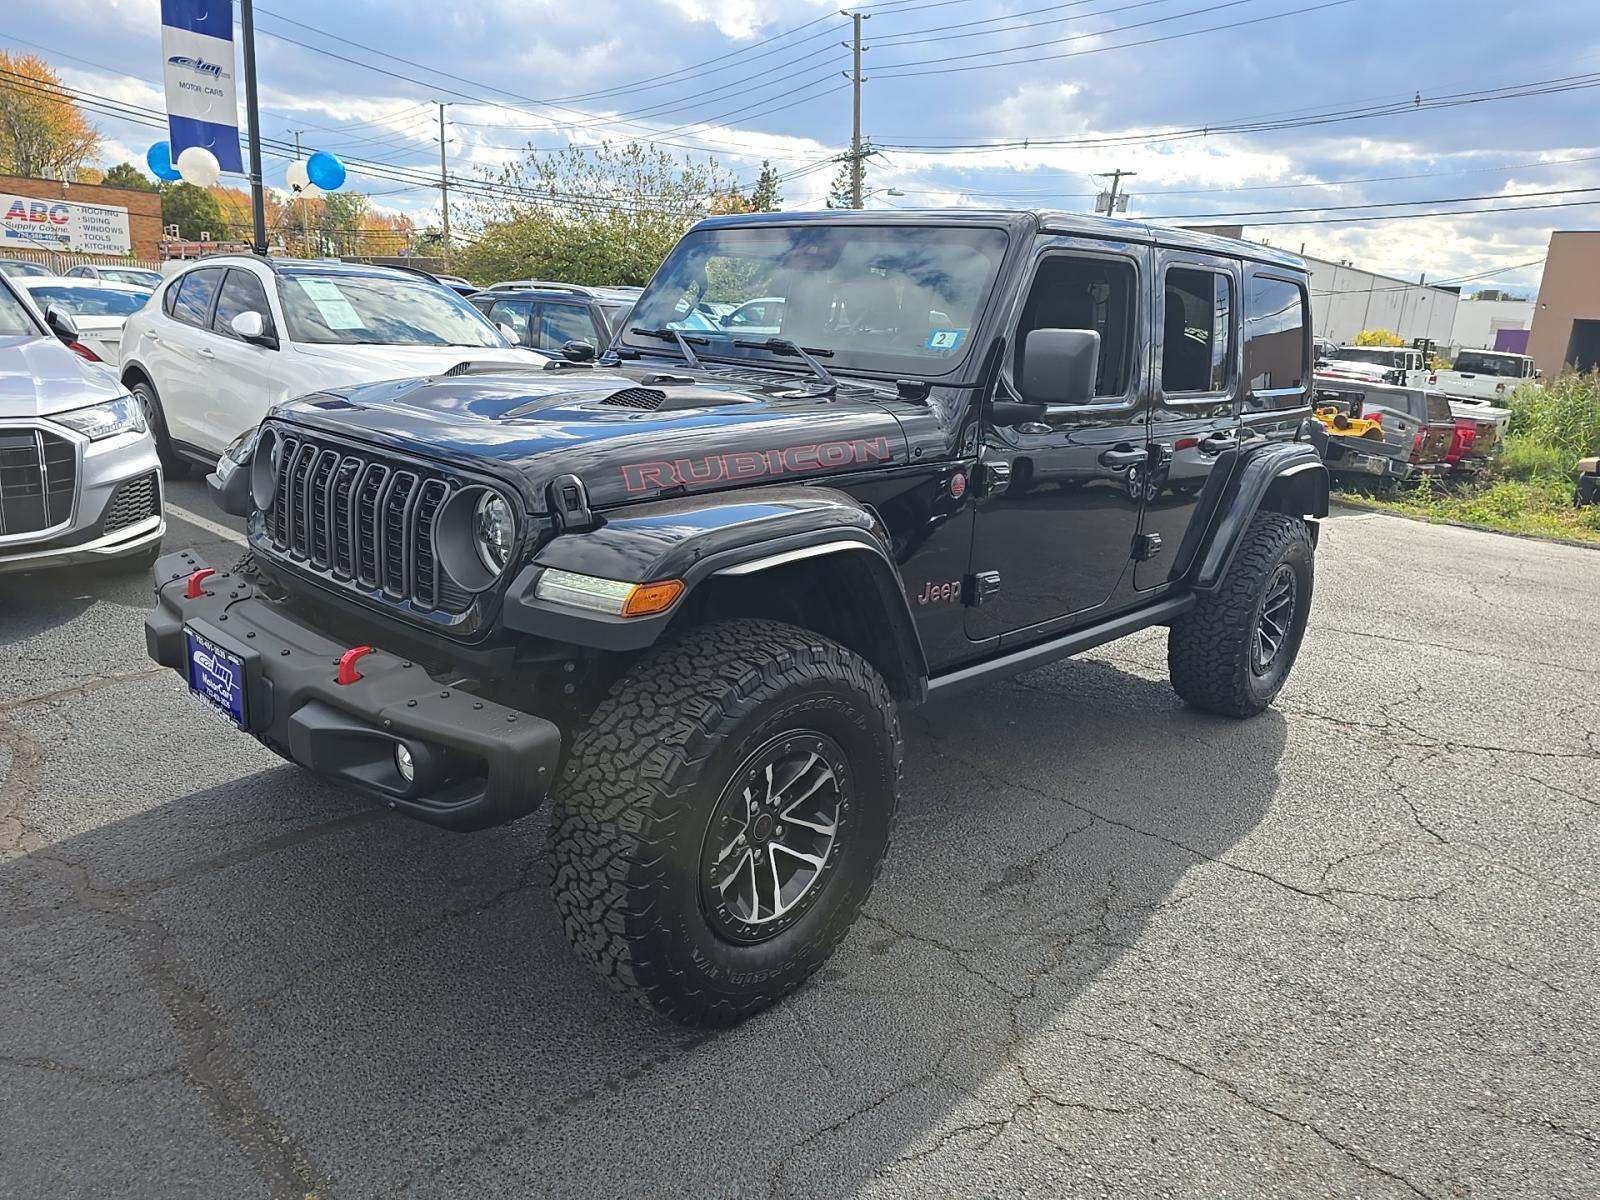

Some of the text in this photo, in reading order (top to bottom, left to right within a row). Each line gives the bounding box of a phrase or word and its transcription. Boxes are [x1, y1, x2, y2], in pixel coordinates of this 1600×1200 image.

[178, 80, 225, 97] MOTOR CARS
[3, 200, 70, 225] ABC
[81, 207, 119, 217] ROOFING
[82, 216, 111, 225] SIDING
[83, 225, 124, 235] WINDOWS
[84, 233, 112, 242] TOOLS
[84, 242, 124, 252] KITCHENS
[621, 436, 891, 492] RUBICON
[918, 581, 961, 605] Jeep
